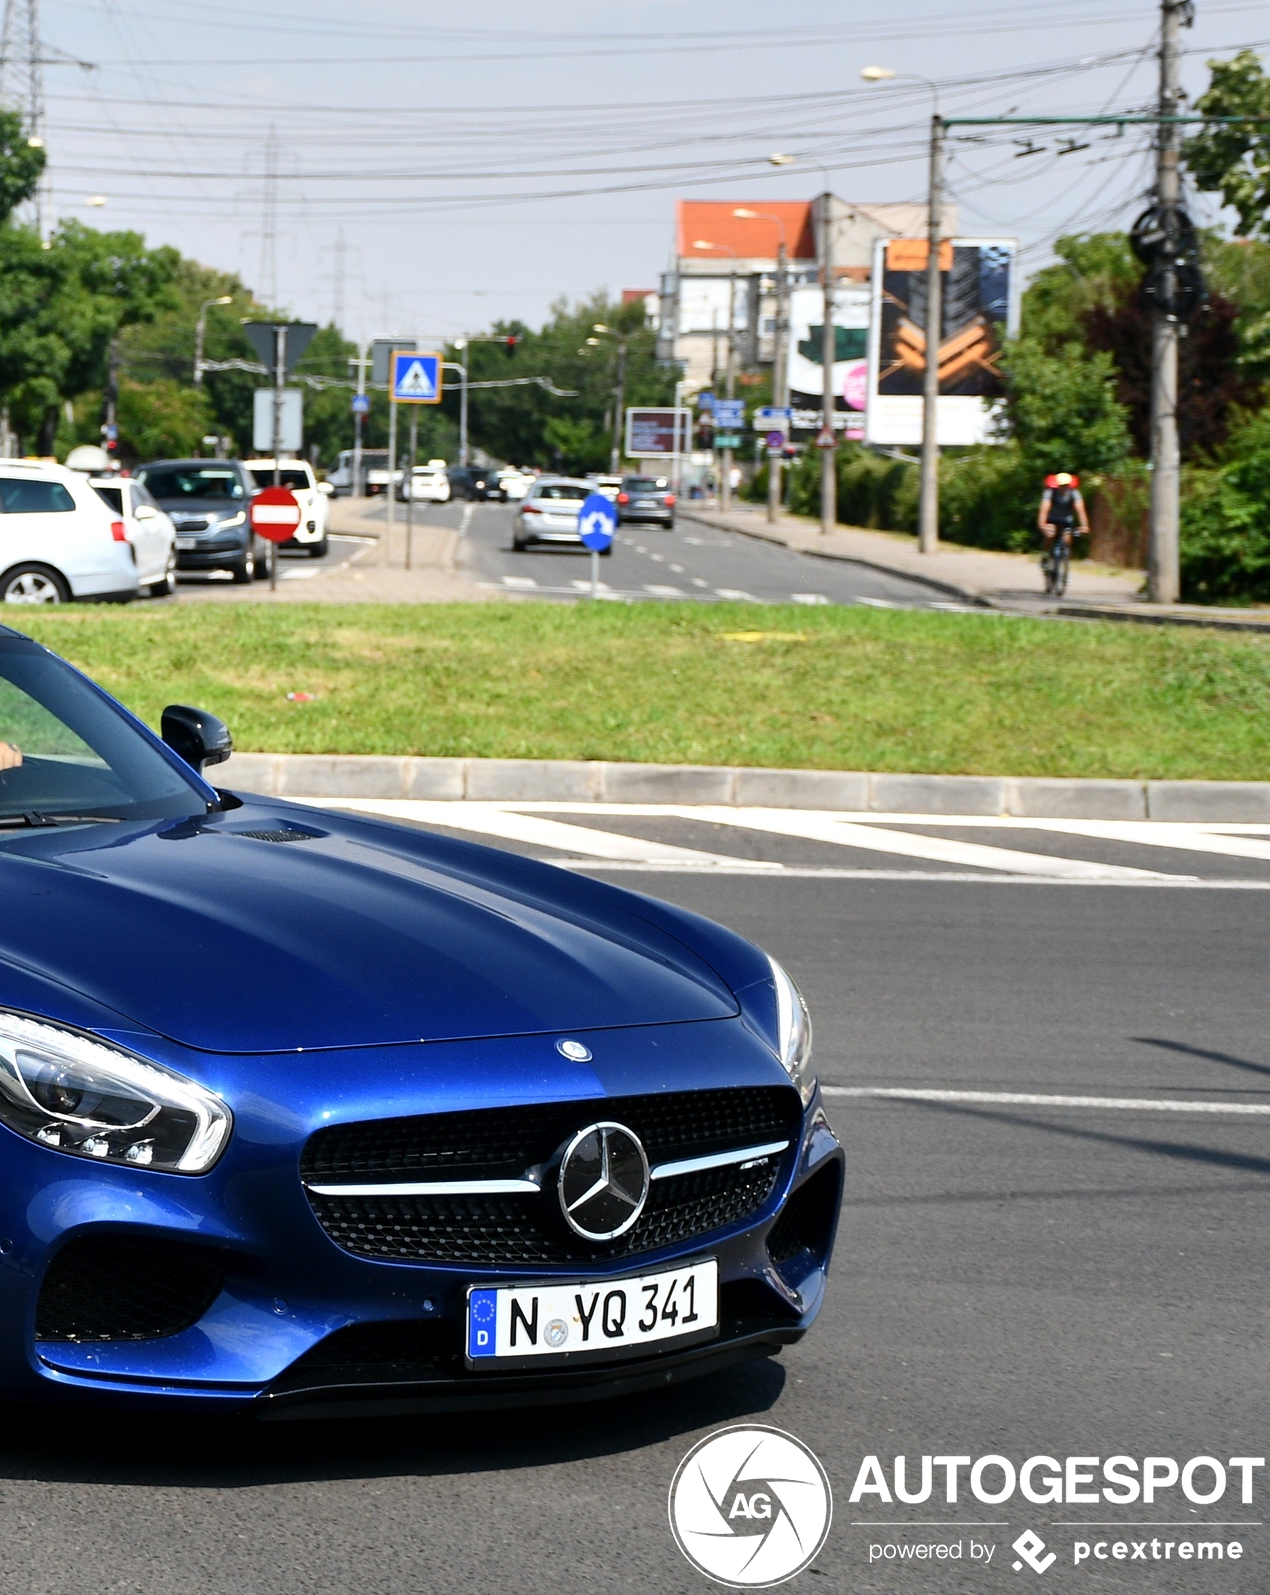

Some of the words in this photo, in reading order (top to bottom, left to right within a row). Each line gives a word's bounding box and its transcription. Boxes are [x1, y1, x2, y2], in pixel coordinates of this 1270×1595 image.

[510, 1296, 538, 1347] N
[575, 1289, 627, 1342] YQ
[638, 1274, 699, 1333] 341
[476, 1330, 489, 1346] D
